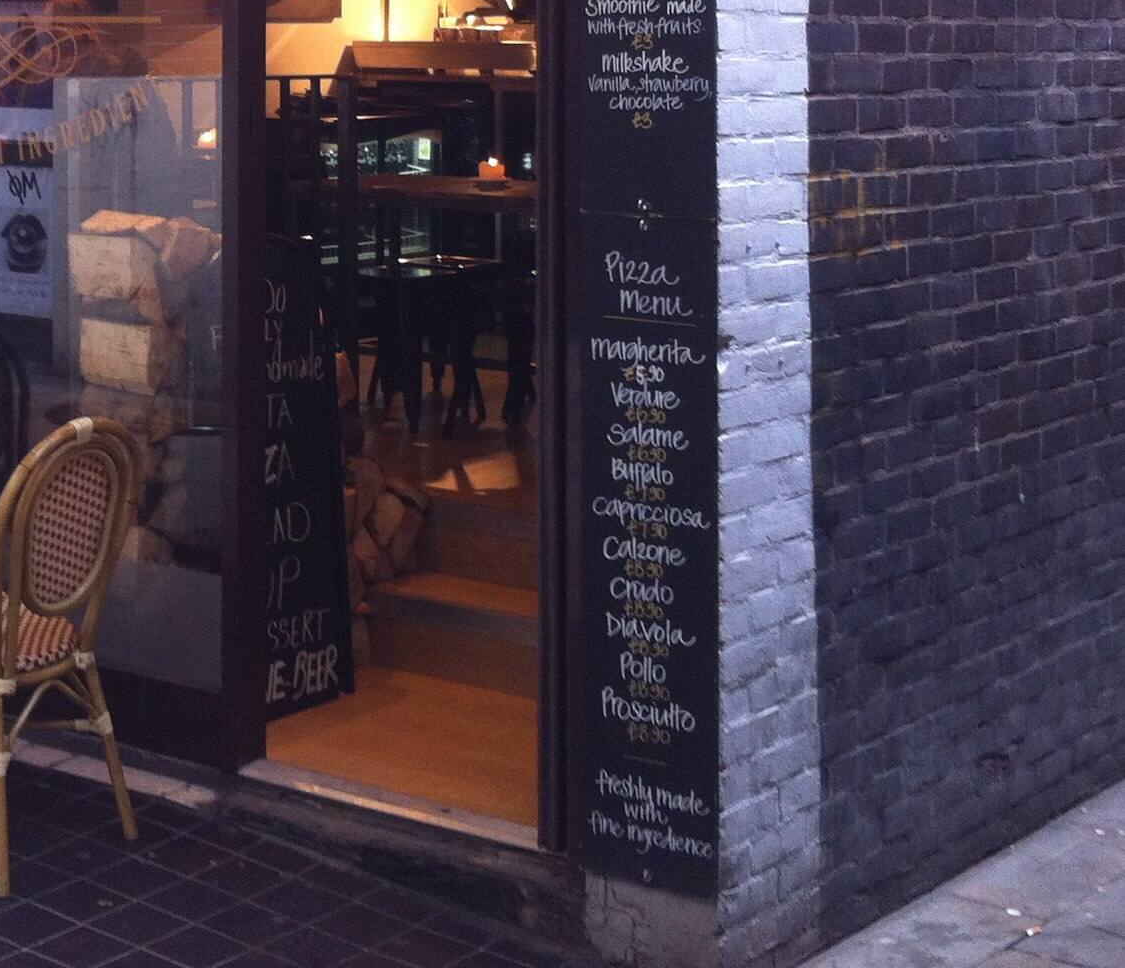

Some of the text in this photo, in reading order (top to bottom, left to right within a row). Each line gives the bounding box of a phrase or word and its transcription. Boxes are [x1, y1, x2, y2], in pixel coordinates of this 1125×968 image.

[587, 16, 702, 40] with fresh fruits
[609, 93, 683, 111] chocolate
[605, 250, 680, 285] Pizza
[611, 382, 681, 410] Verdure
[607, 423, 689, 451] Salame
[612, 457, 674, 492] Buffalo
[592, 496, 711, 530] Capricciosa
[603, 535, 686, 567] Calzone
[610, 576, 674, 604] Crudo
[605, 611, 696, 647] Diavola
[619, 651, 667, 684] Pollo
[602, 685, 696, 732] Prosciutto
[624, 801, 669, 825] with
[656, 786, 710, 816] made
